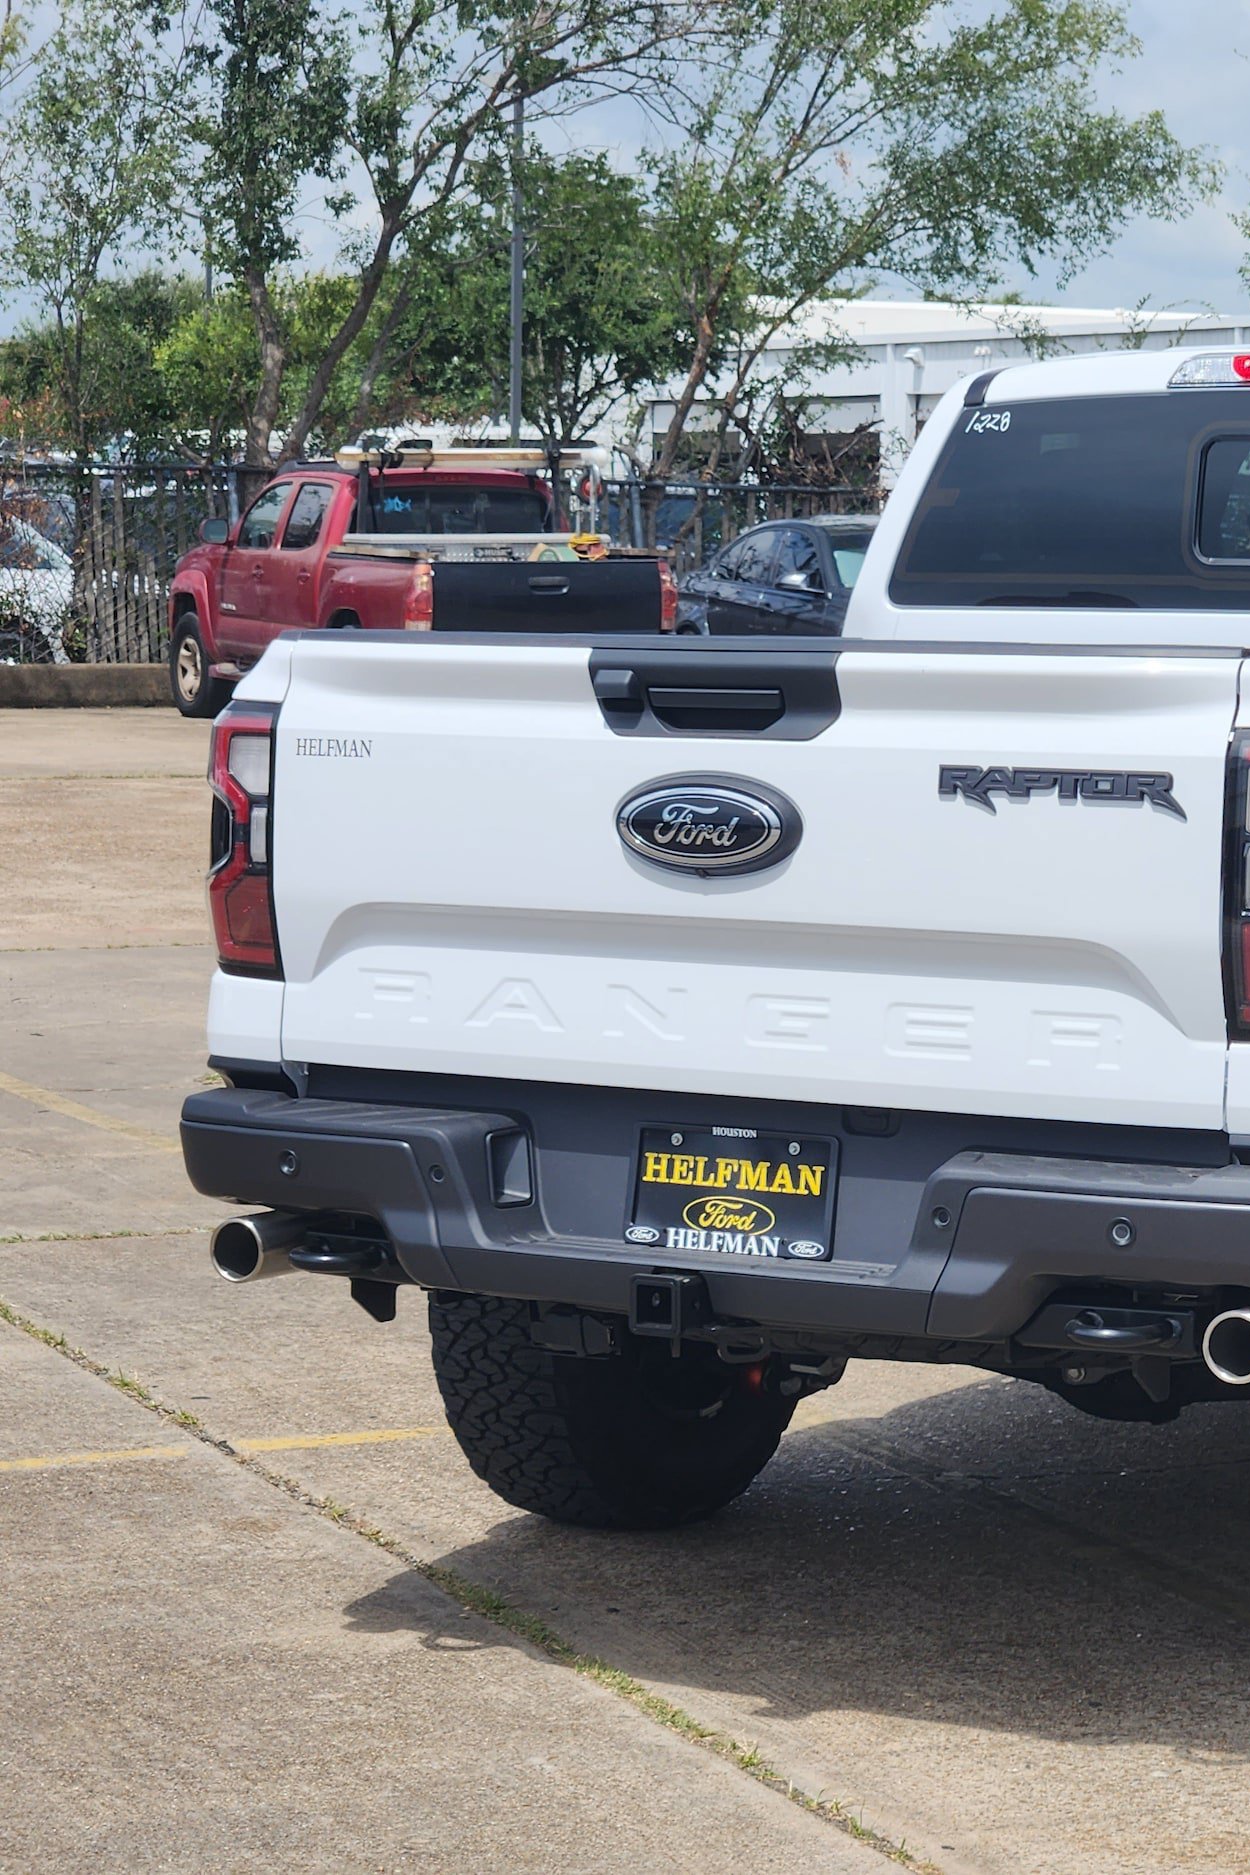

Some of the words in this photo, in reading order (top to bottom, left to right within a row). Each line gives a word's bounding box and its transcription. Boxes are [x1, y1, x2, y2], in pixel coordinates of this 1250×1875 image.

[964, 410, 1011, 433] 1228
[296, 738, 373, 758] HELFMAN
[938, 764, 1188, 823] RAPTOR
[653, 803, 741, 847] Ford
[353, 967, 1124, 1070] RANGER
[712, 1126, 757, 1138] HOUSTON
[642, 1152, 826, 1196] HELFMAN
[698, 1199, 758, 1231] Ford
[666, 1227, 780, 1257] HELFMAN
